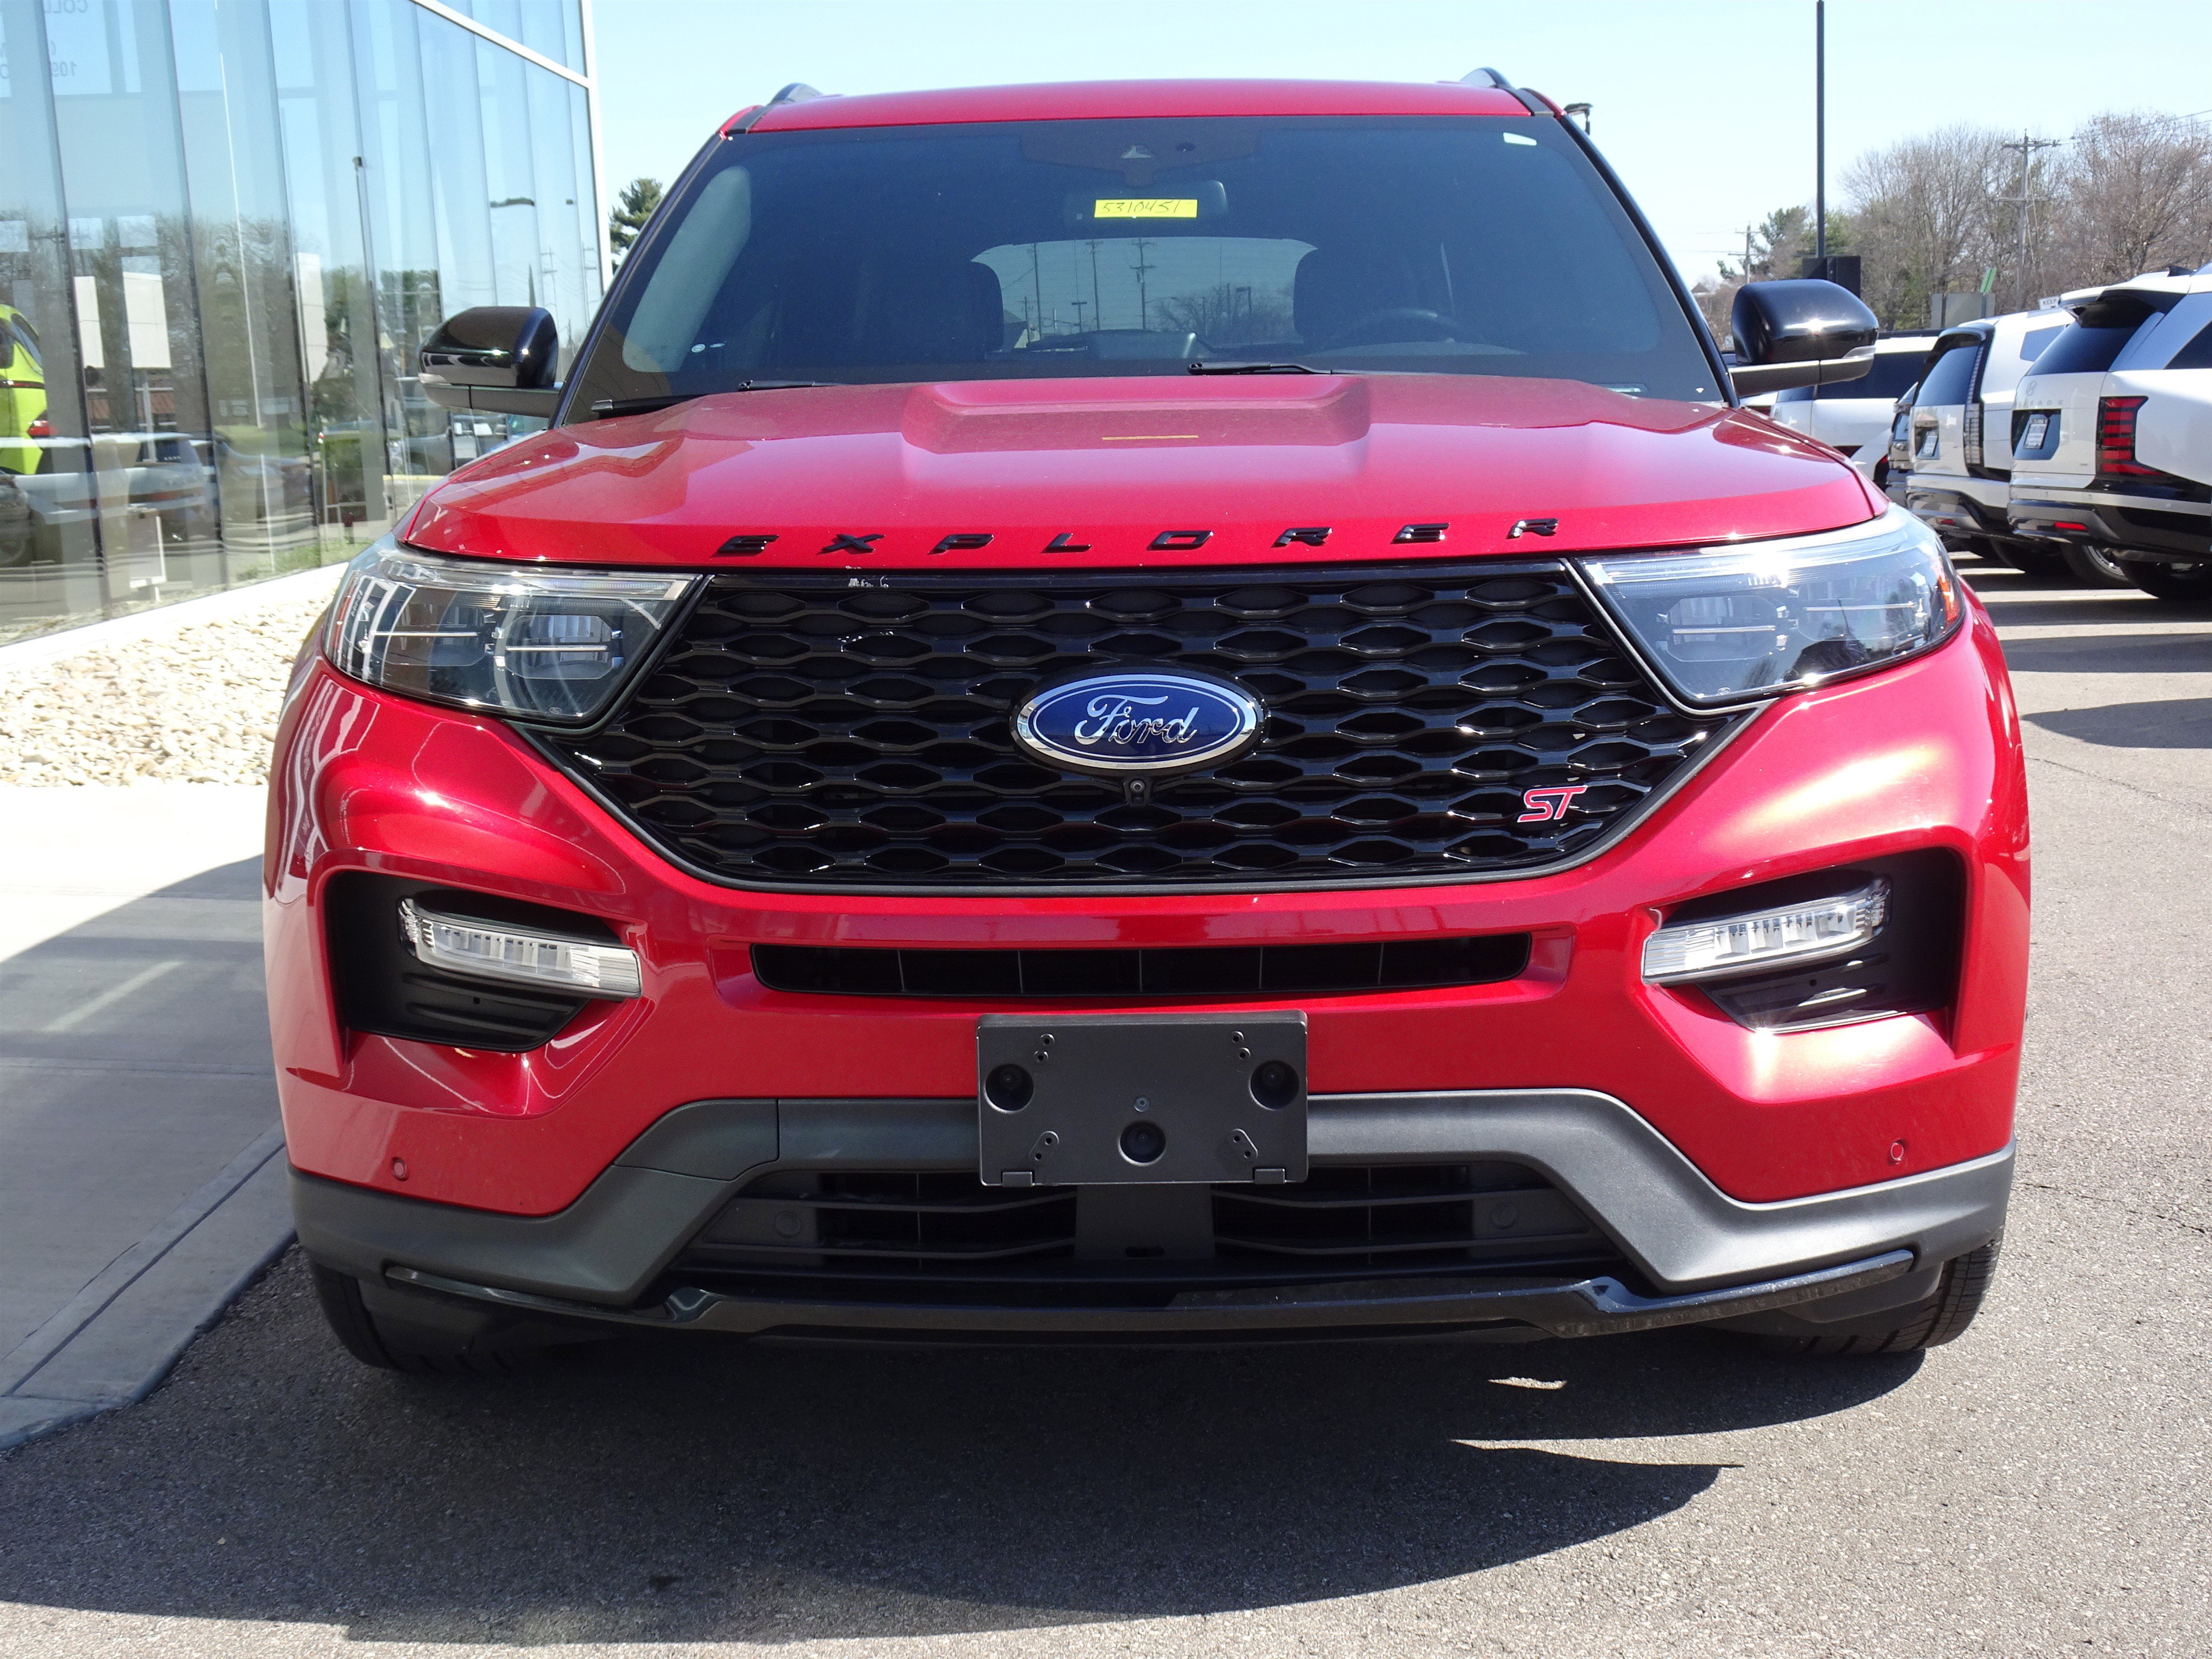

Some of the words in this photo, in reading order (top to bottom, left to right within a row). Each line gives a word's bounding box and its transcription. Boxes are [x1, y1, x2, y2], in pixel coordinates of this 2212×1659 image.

[1097, 199, 1181, 214] 5310451
[717, 517, 1559, 554] EXPLORER
[1074, 694, 1199, 745] Ford
[1517, 785, 1588, 823] ST
